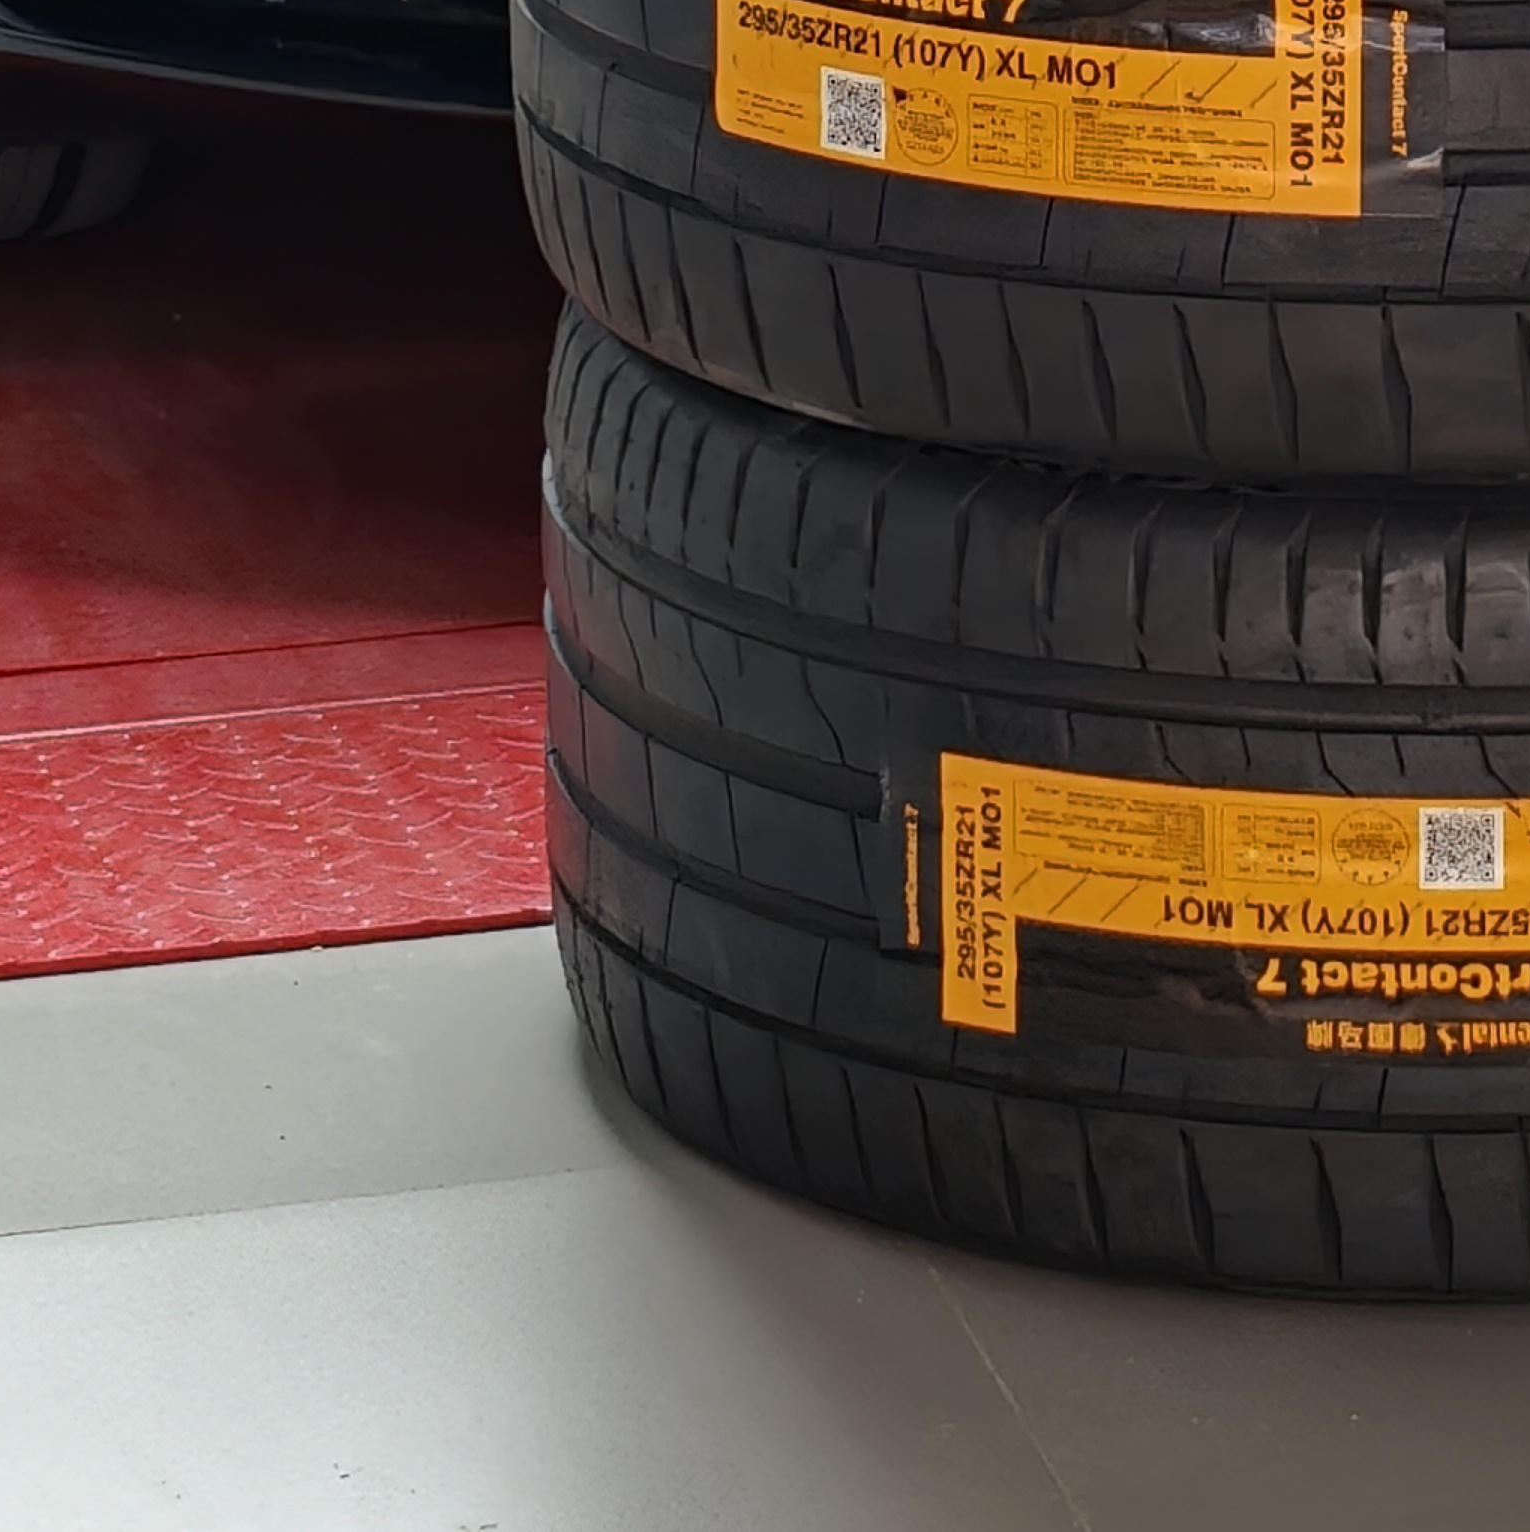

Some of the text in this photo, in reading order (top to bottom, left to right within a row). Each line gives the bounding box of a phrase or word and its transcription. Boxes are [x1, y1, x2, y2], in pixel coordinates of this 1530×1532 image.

[737, 0, 1118, 89] 295/35ZR21 (107Y) XL MO1
[1290, 70, 1315, 111] XL
[1289, 122, 1314, 188] MO1
[956, 805, 977, 981] 295/35ZR21
[980, 785, 1008, 1010] (107Y) XL MO1
[1162, 894, 1234, 929] MO1
[1254, 903, 1291, 933] XL
[1300, 901, 1411, 937] (107Y)
[1256, 956, 1287, 996] 7
